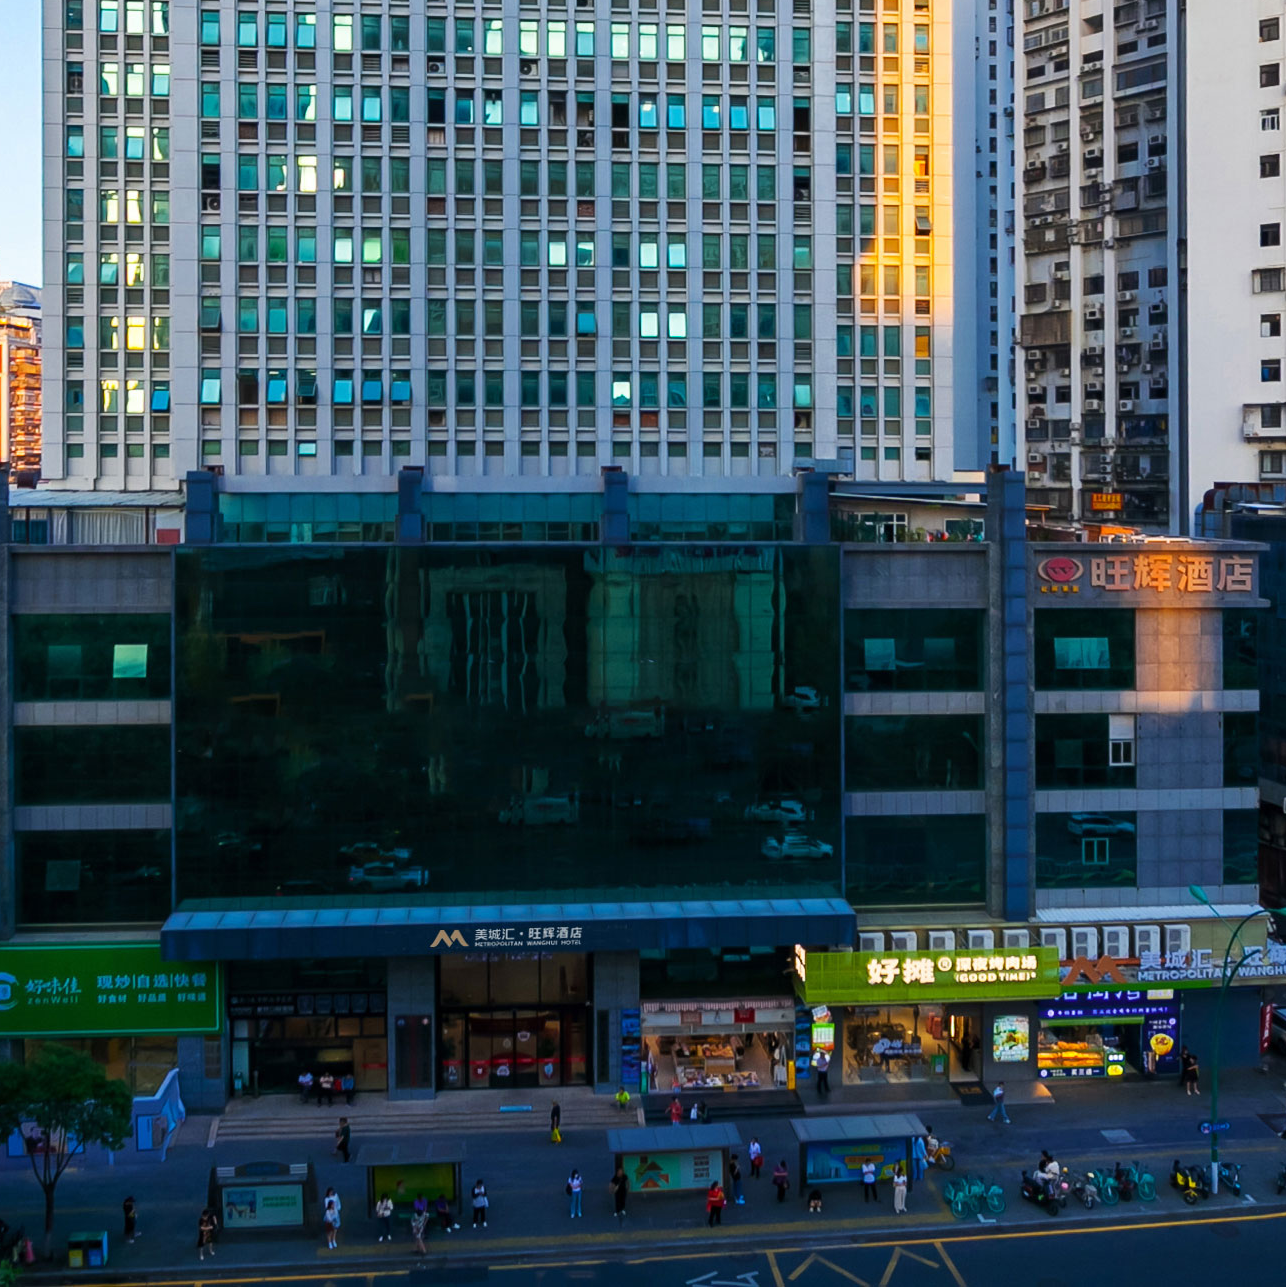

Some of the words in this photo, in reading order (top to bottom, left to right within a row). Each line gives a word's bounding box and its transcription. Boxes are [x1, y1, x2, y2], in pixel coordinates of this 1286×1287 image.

[1090, 553, 1254, 593] 旺辉酒店
[1137, 967, 1232, 982] METROPOLITAN
[24, 976, 82, 995] 好味佳
